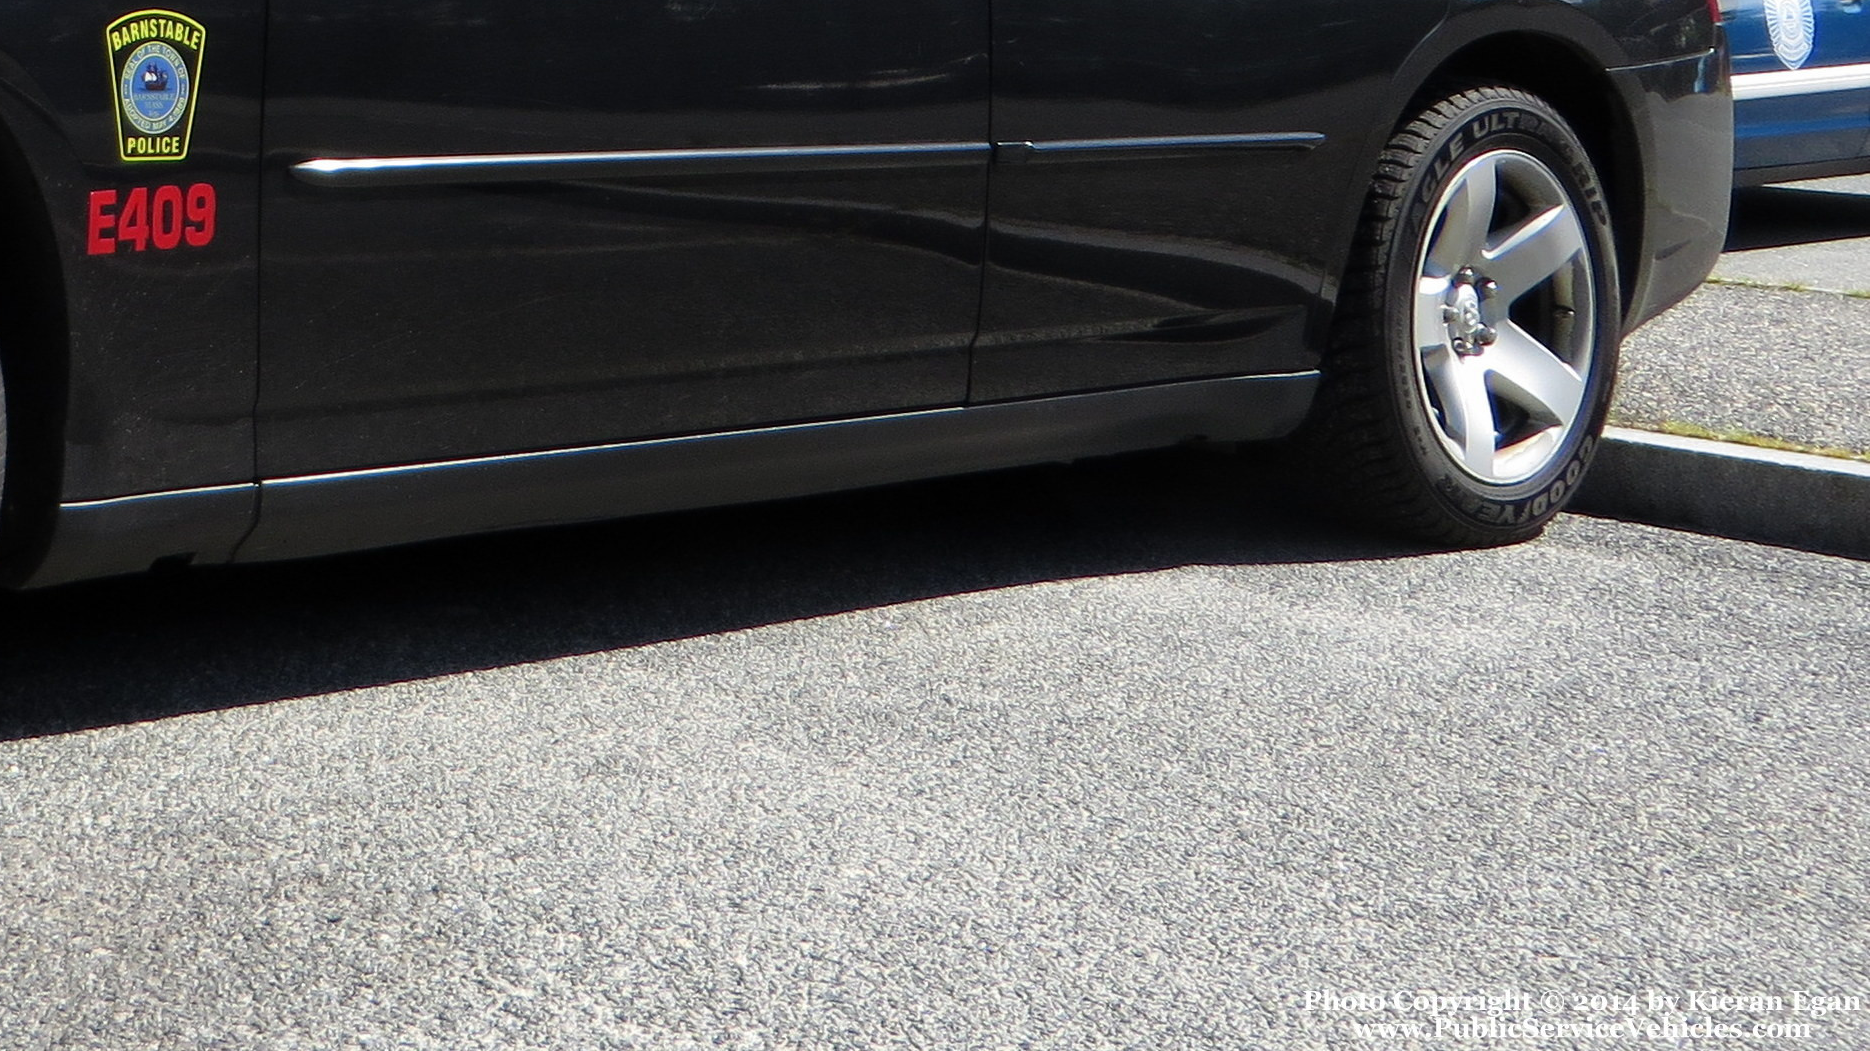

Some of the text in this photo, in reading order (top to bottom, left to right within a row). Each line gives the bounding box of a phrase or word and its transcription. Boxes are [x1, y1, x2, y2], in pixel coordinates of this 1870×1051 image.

[111, 18, 201, 52] BARNSTABLE
[127, 136, 180, 154] POLICE
[86, 182, 216, 256] E409
